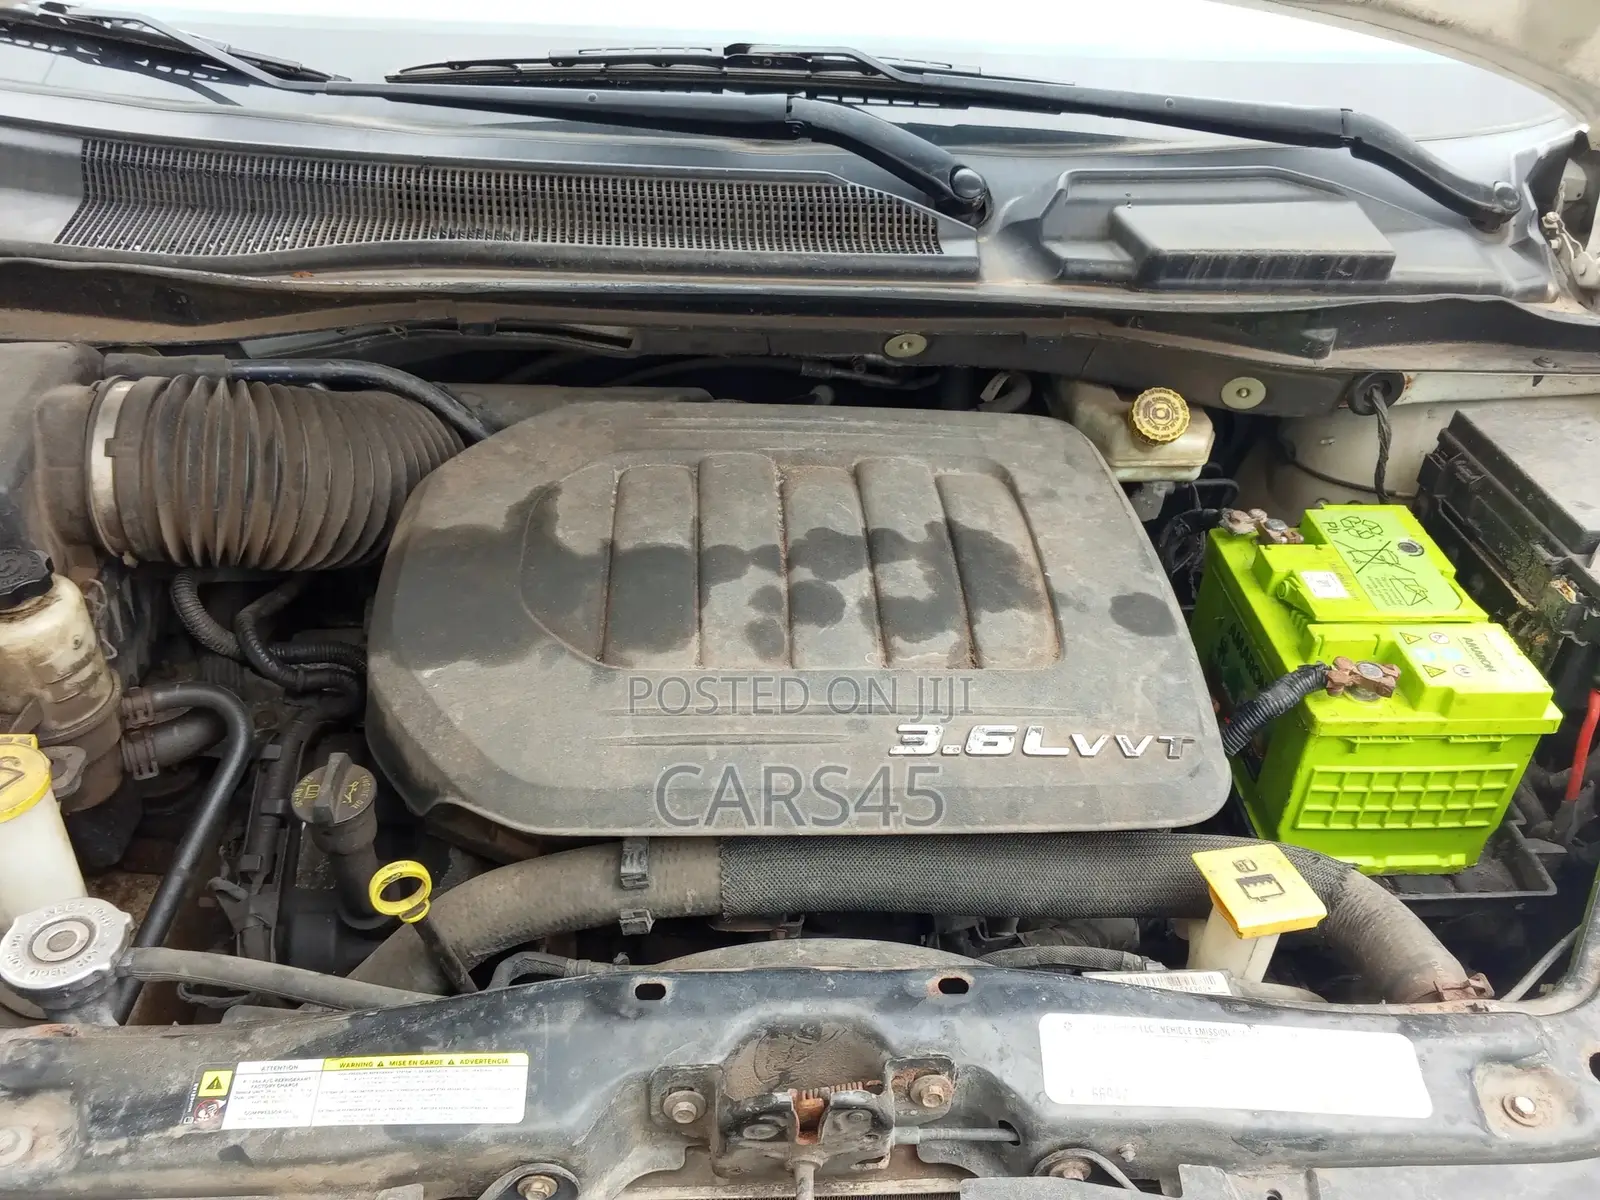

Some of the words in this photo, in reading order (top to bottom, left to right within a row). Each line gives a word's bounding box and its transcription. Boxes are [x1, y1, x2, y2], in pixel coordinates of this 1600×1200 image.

[1321, 521, 1341, 534] Pb
[1461, 636, 1497, 673] AMARON
[1160, 1026, 1192, 1036] VEHICLE
[260, 1064, 299, 1072] ATTENTION
